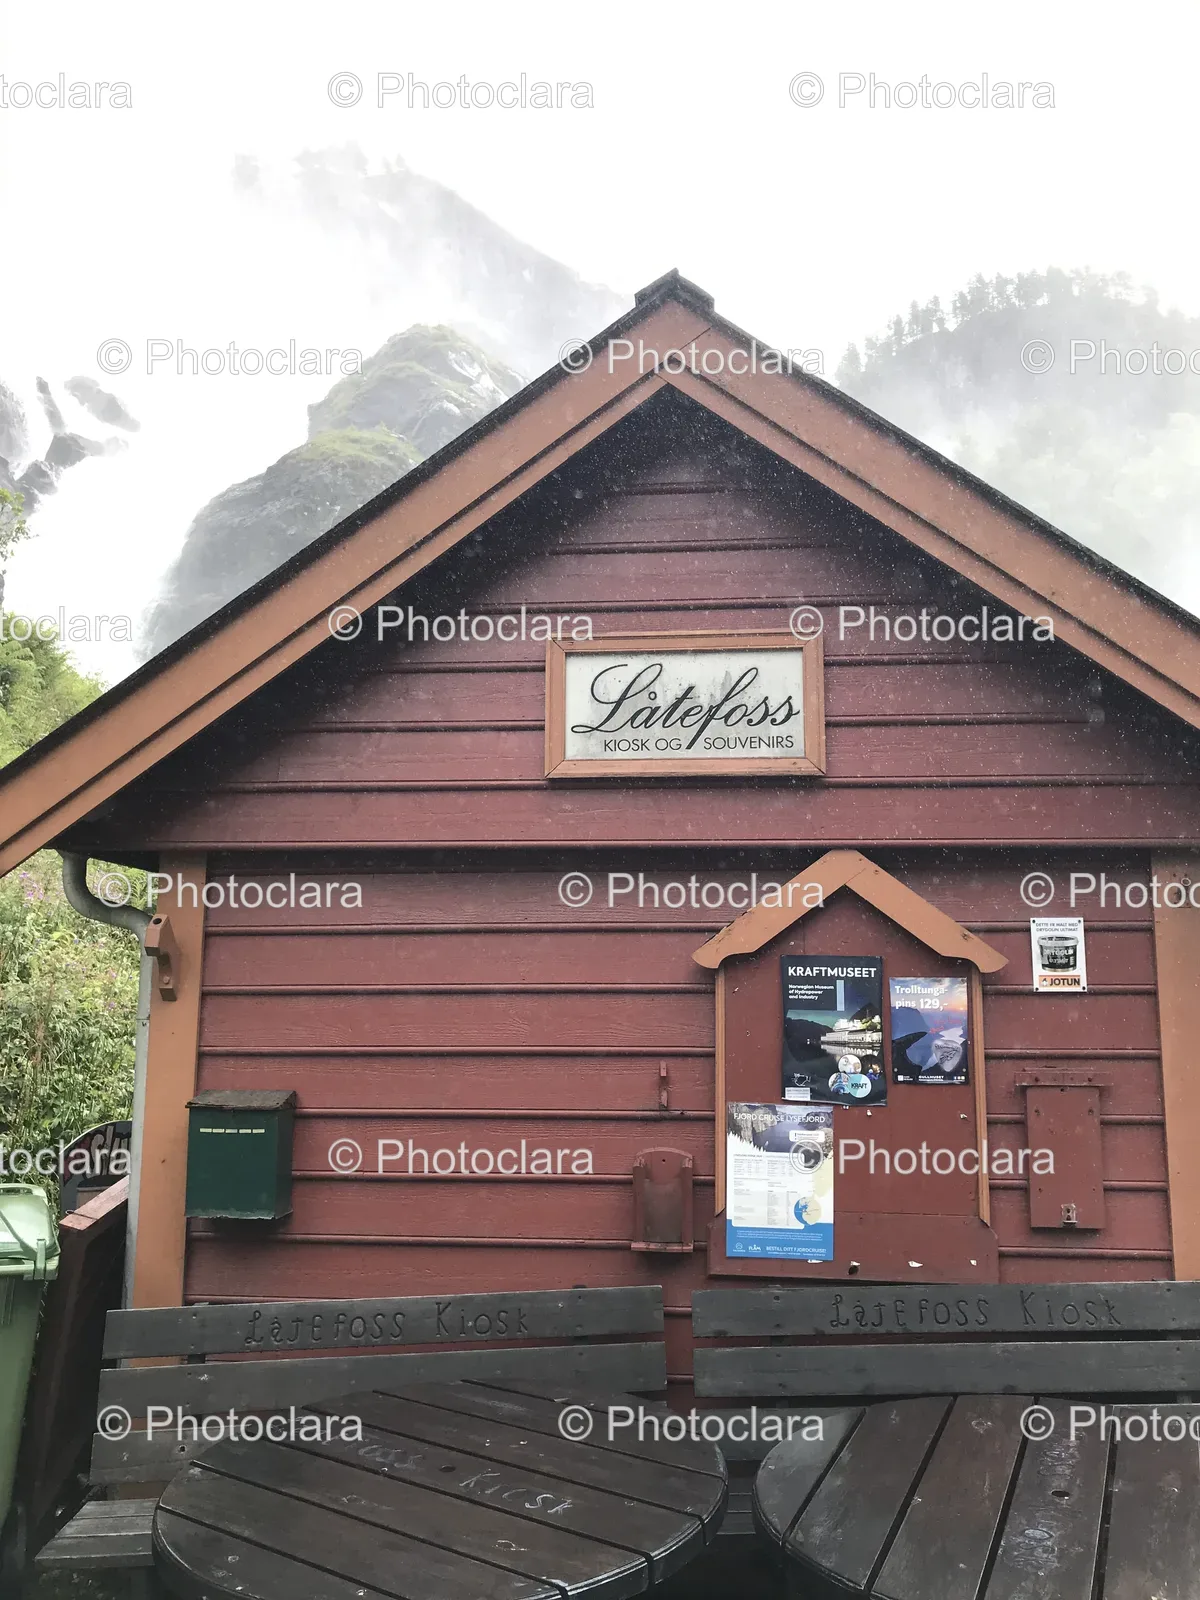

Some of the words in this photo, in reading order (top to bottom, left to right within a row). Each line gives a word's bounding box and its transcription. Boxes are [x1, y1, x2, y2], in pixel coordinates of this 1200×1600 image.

[571, 663, 800, 749] Låtefoss
[604, 737, 650, 752] KIOSK
[655, 737, 682, 751] OG
[703, 735, 794, 750] SOUVENIRS
[788, 966, 877, 978] KRAFTMUSEET
[1050, 978, 1080, 986] JOTUN
[895, 985, 948, 997] Trolltunga-
[895, 998, 916, 1009] pins
[919, 998, 949, 1011] 129,-
[733, 1112, 757, 1121] FJORD
[758, 1113, 785, 1122] CRUISE
[786, 1114, 826, 1123] LYSEFJORD
